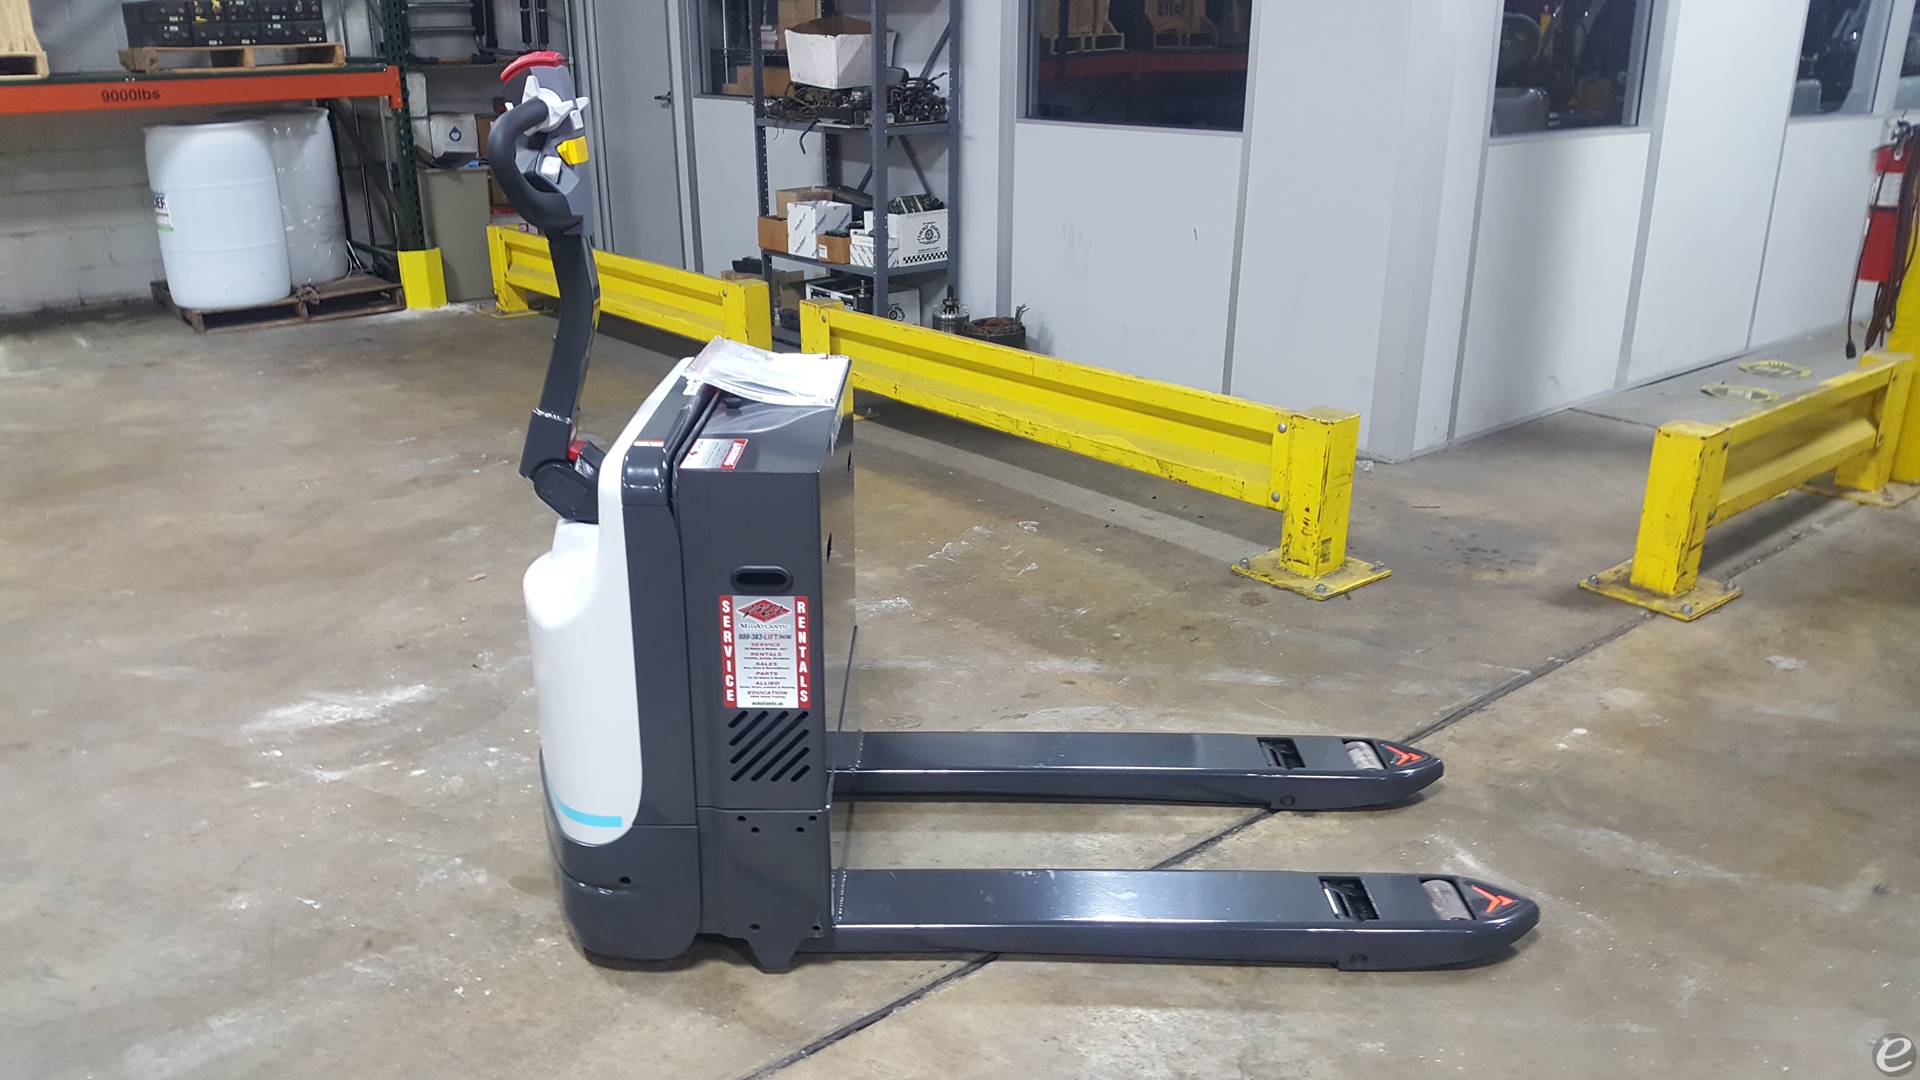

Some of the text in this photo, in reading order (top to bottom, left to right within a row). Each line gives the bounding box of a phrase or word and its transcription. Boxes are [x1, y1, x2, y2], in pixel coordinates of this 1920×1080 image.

[101, 88, 160, 101] 9000lbs
[722, 600, 734, 702] SERVICE
[797, 601, 808, 702] RENTALS
